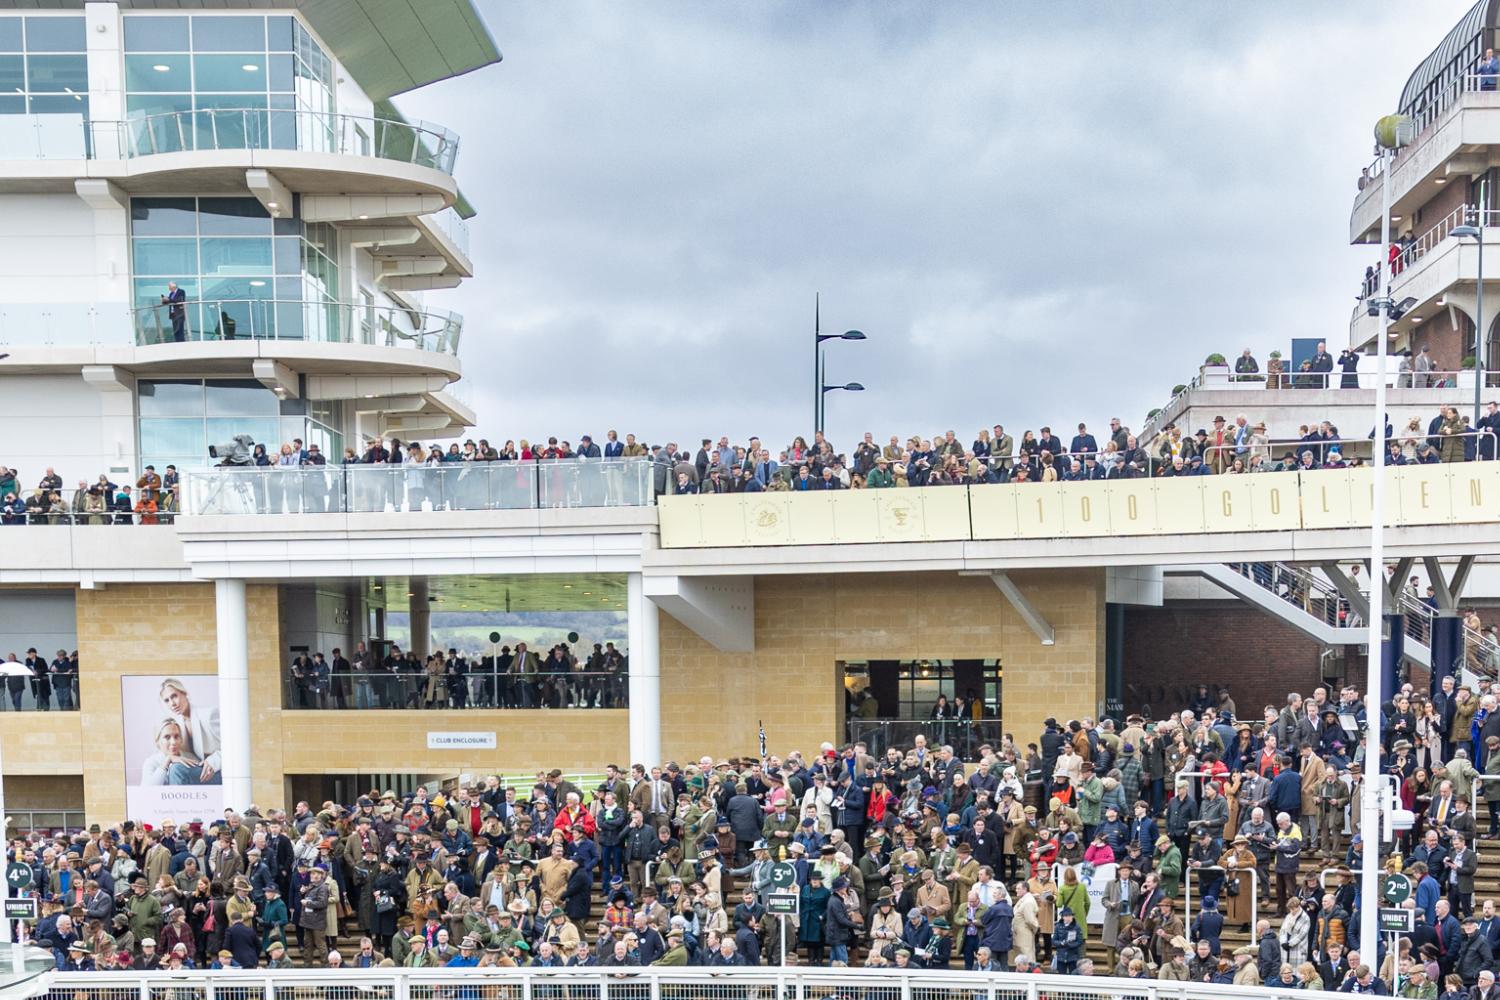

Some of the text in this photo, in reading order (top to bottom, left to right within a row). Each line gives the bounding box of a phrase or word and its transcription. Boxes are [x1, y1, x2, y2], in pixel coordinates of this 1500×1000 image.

[1036, 494, 1138, 524] 100
[1222, 479, 1483, 518] GOLEN
[161, 791, 208, 800] BOODLES
[9, 868, 28, 882] 4th
[774, 868, 792, 882] 3rd
[1387, 880, 1407, 896] 2nd
[6, 903, 33, 911] UNIBET
[1382, 914, 1407, 922] UNIBET
